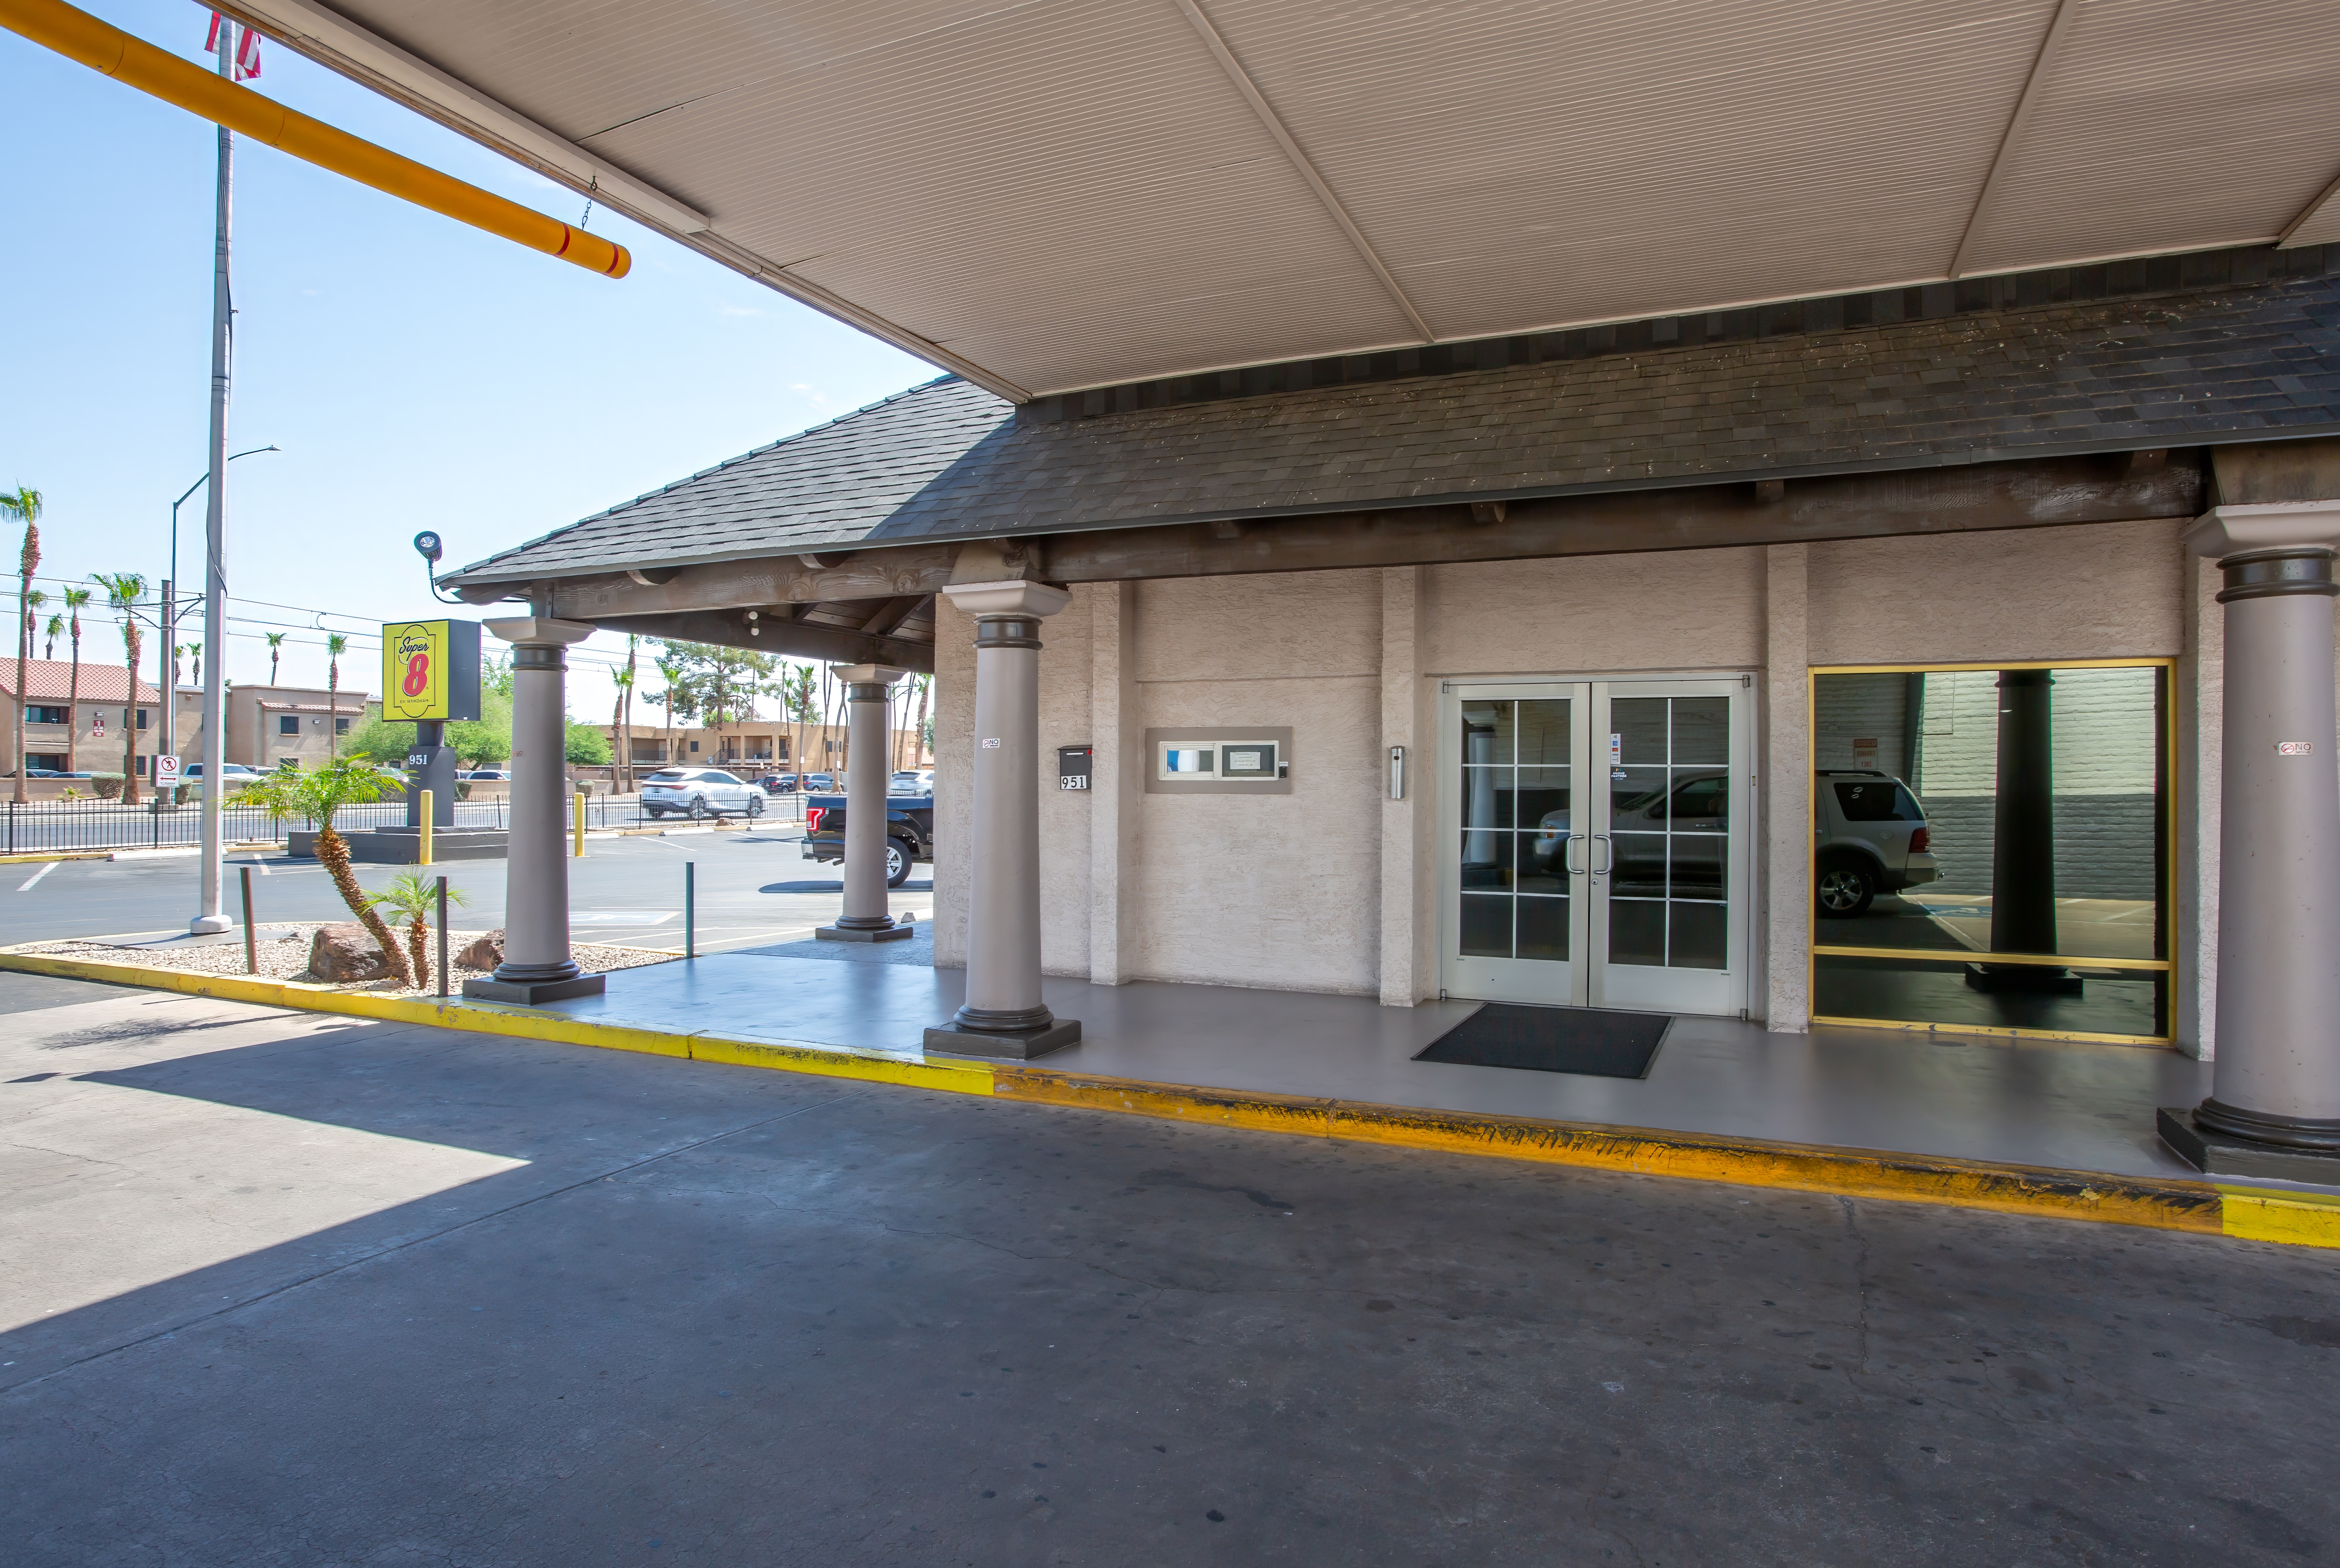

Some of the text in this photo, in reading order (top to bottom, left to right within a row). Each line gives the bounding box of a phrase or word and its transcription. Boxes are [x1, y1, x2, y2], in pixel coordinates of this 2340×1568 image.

[399, 636, 429, 661] Super
[402, 654, 429, 697] 8
[409, 754, 427, 764] 951
[1062, 777, 1084, 788] 951
